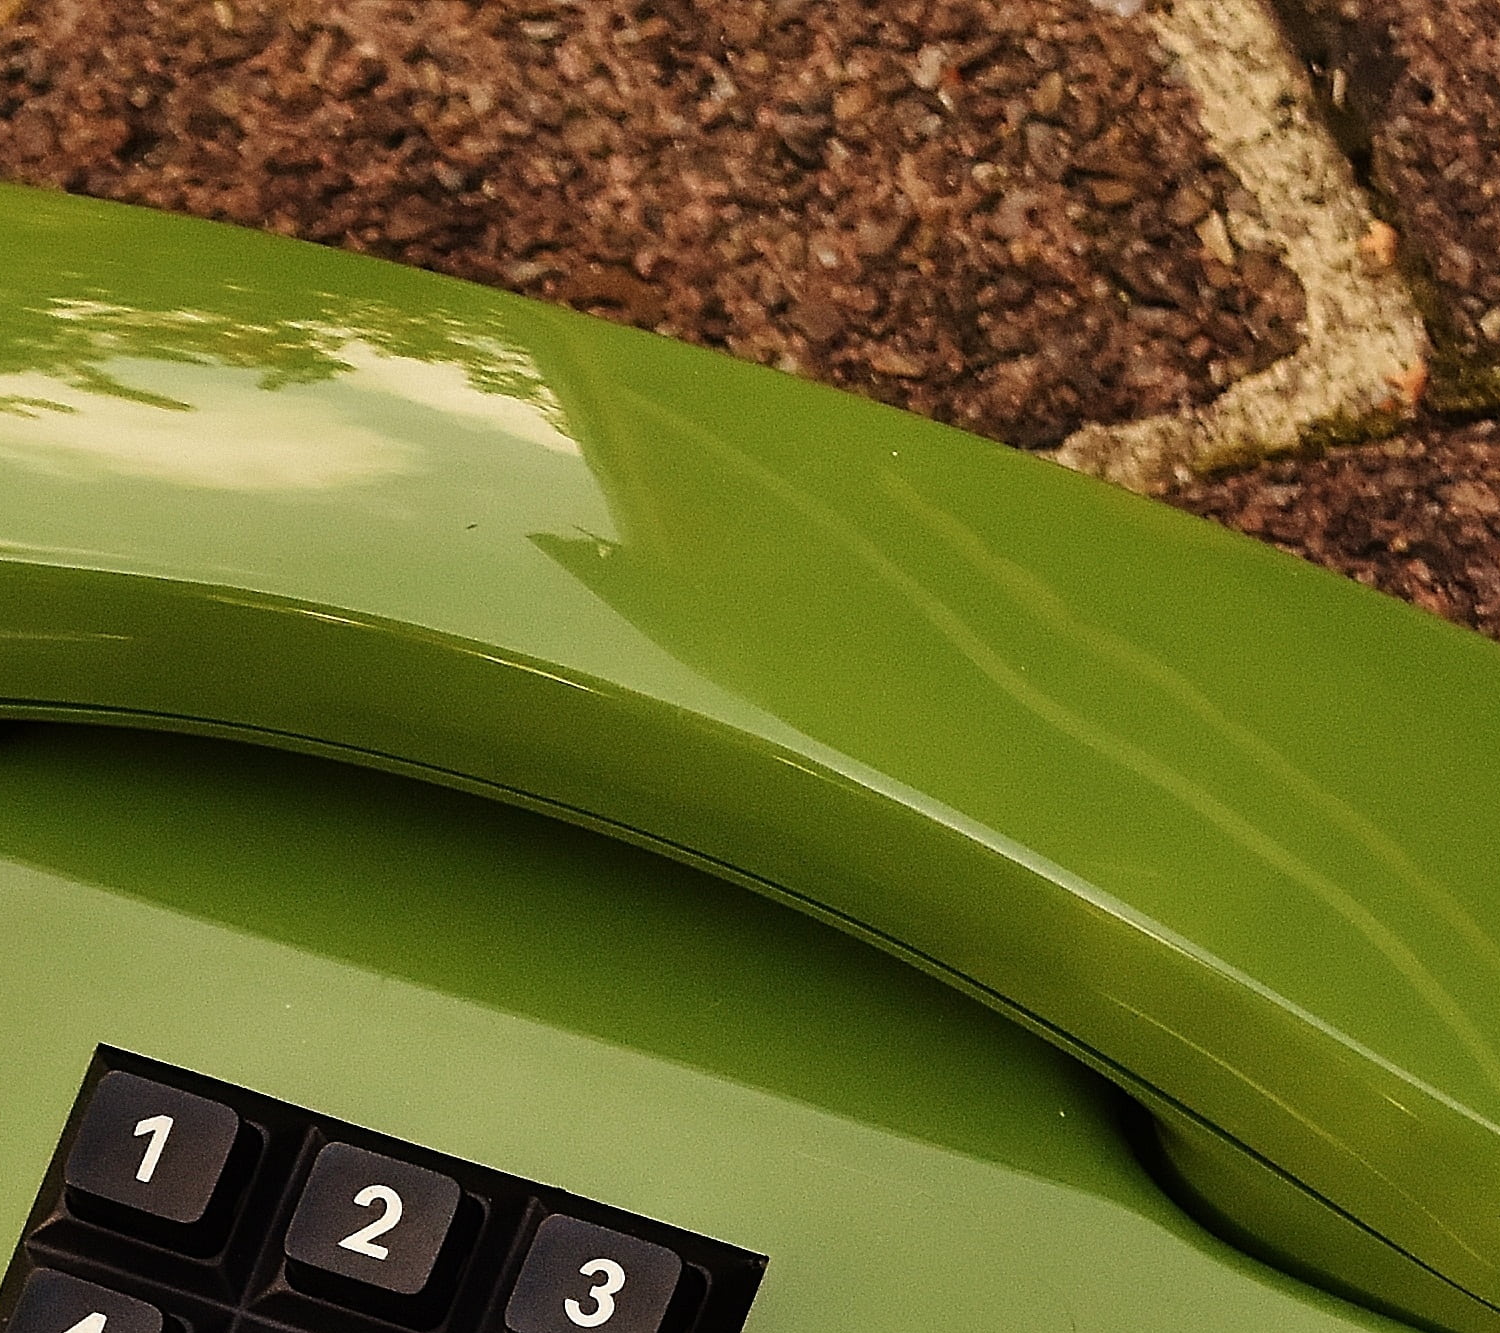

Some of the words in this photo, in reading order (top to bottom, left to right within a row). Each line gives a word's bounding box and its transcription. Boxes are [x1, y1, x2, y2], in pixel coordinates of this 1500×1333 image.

[132, 1113, 175, 1184] 1
[336, 1183, 404, 1261] 2
[563, 1257, 627, 1329] 3
